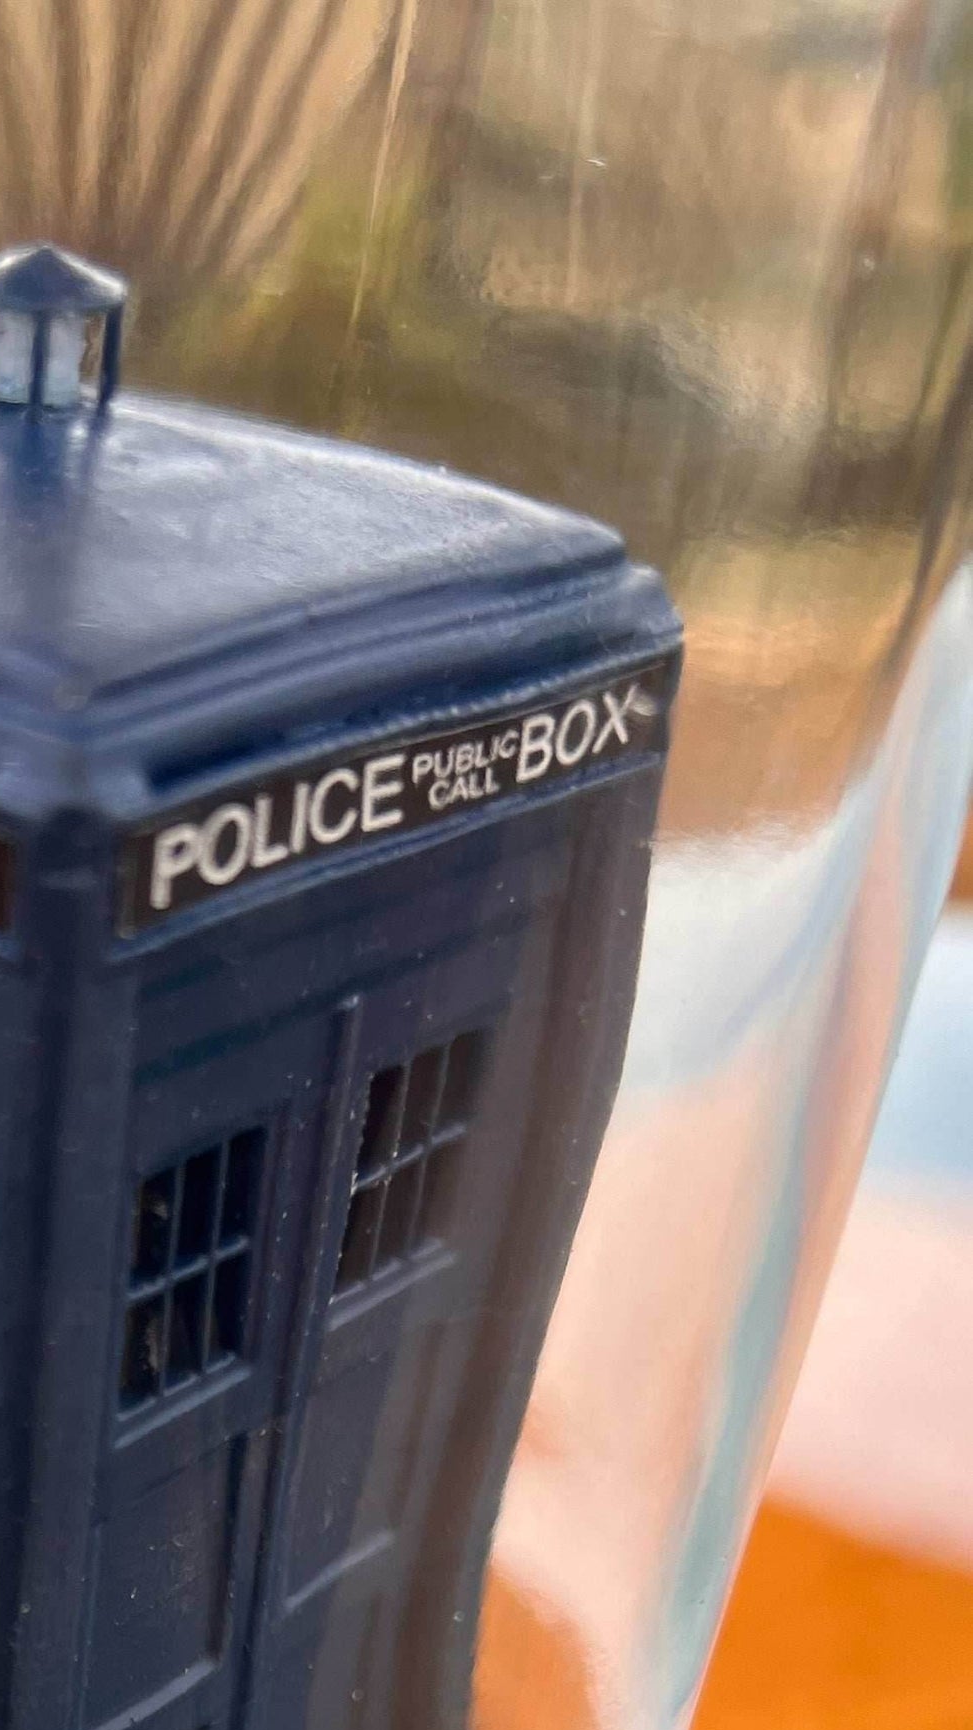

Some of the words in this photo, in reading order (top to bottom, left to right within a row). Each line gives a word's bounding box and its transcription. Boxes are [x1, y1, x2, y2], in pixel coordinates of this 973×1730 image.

[411, 730, 517, 785] PUBLIC
[148, 753, 407, 910] POLICE
[515, 684, 645, 783] BOX
[428, 774, 501, 811] CALL
